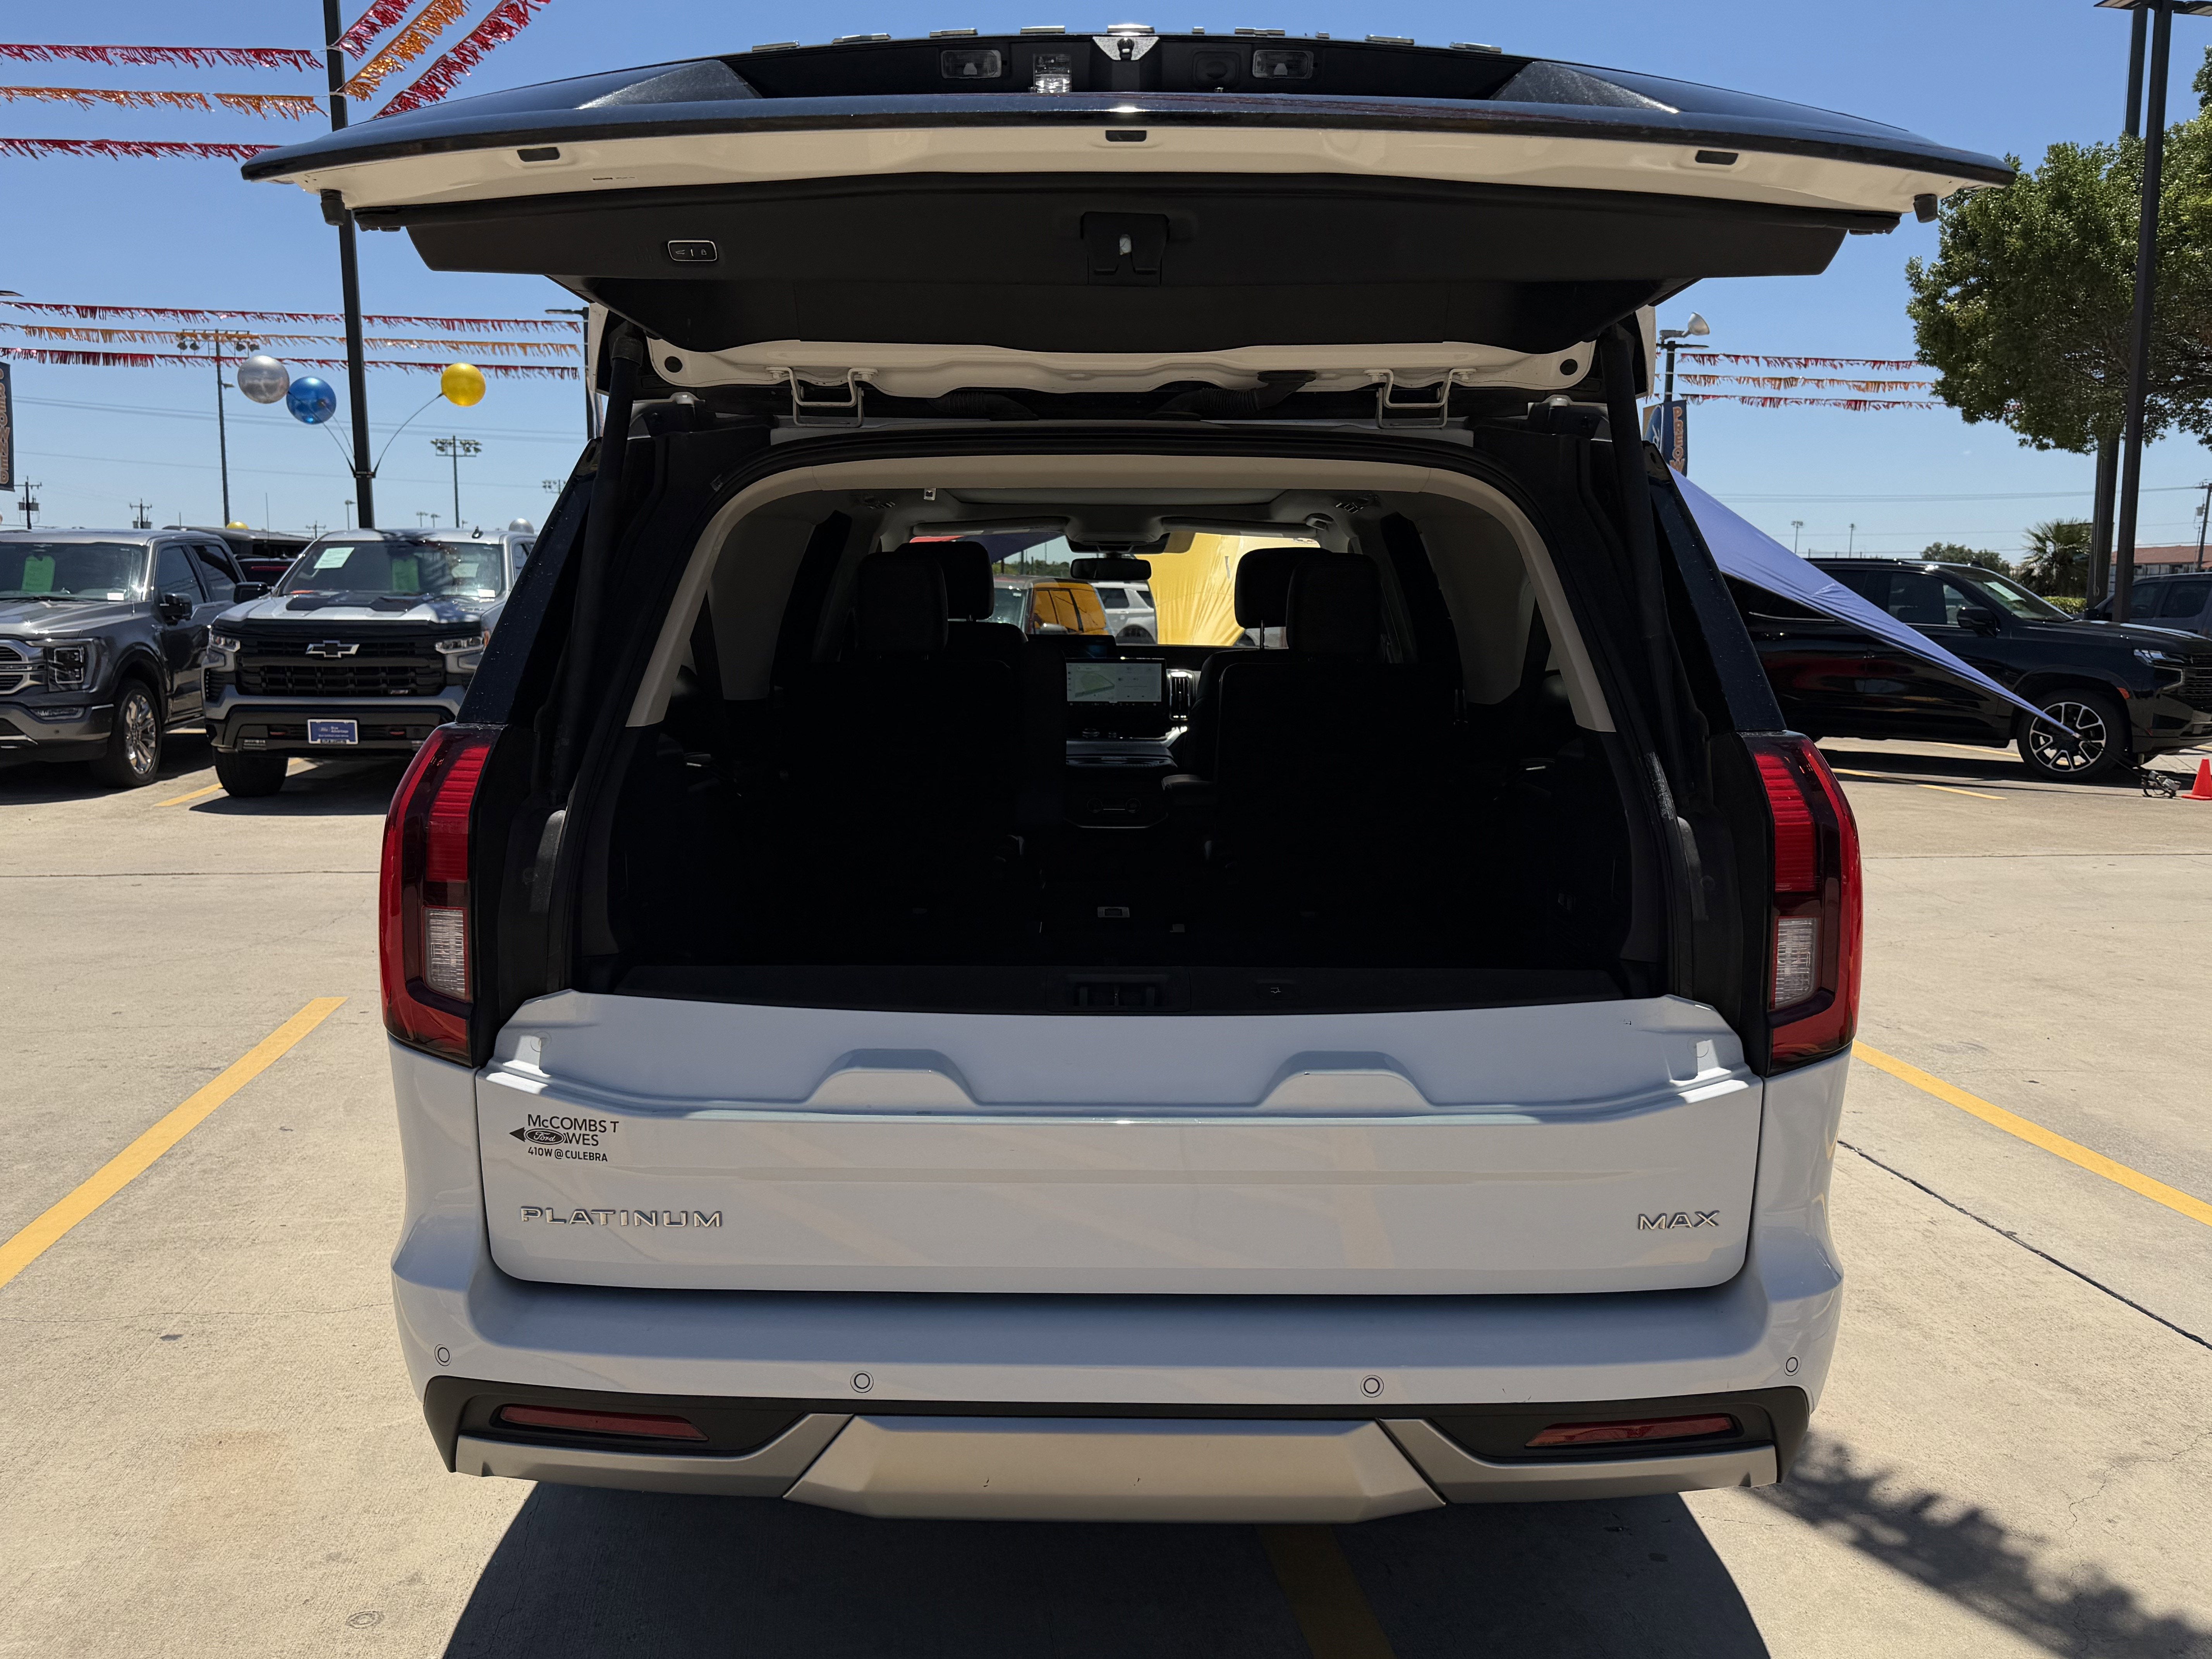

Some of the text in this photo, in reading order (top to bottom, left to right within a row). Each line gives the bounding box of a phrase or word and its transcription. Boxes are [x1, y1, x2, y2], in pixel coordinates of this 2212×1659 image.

[528, 1114, 607, 1133] McCOMBS
[567, 1133, 599, 1146] WES
[528, 1147, 608, 1162] 410W @ CULEBRA
[520, 1206, 722, 1227] PLATINUM
[1638, 1210, 1720, 1230] MAX
